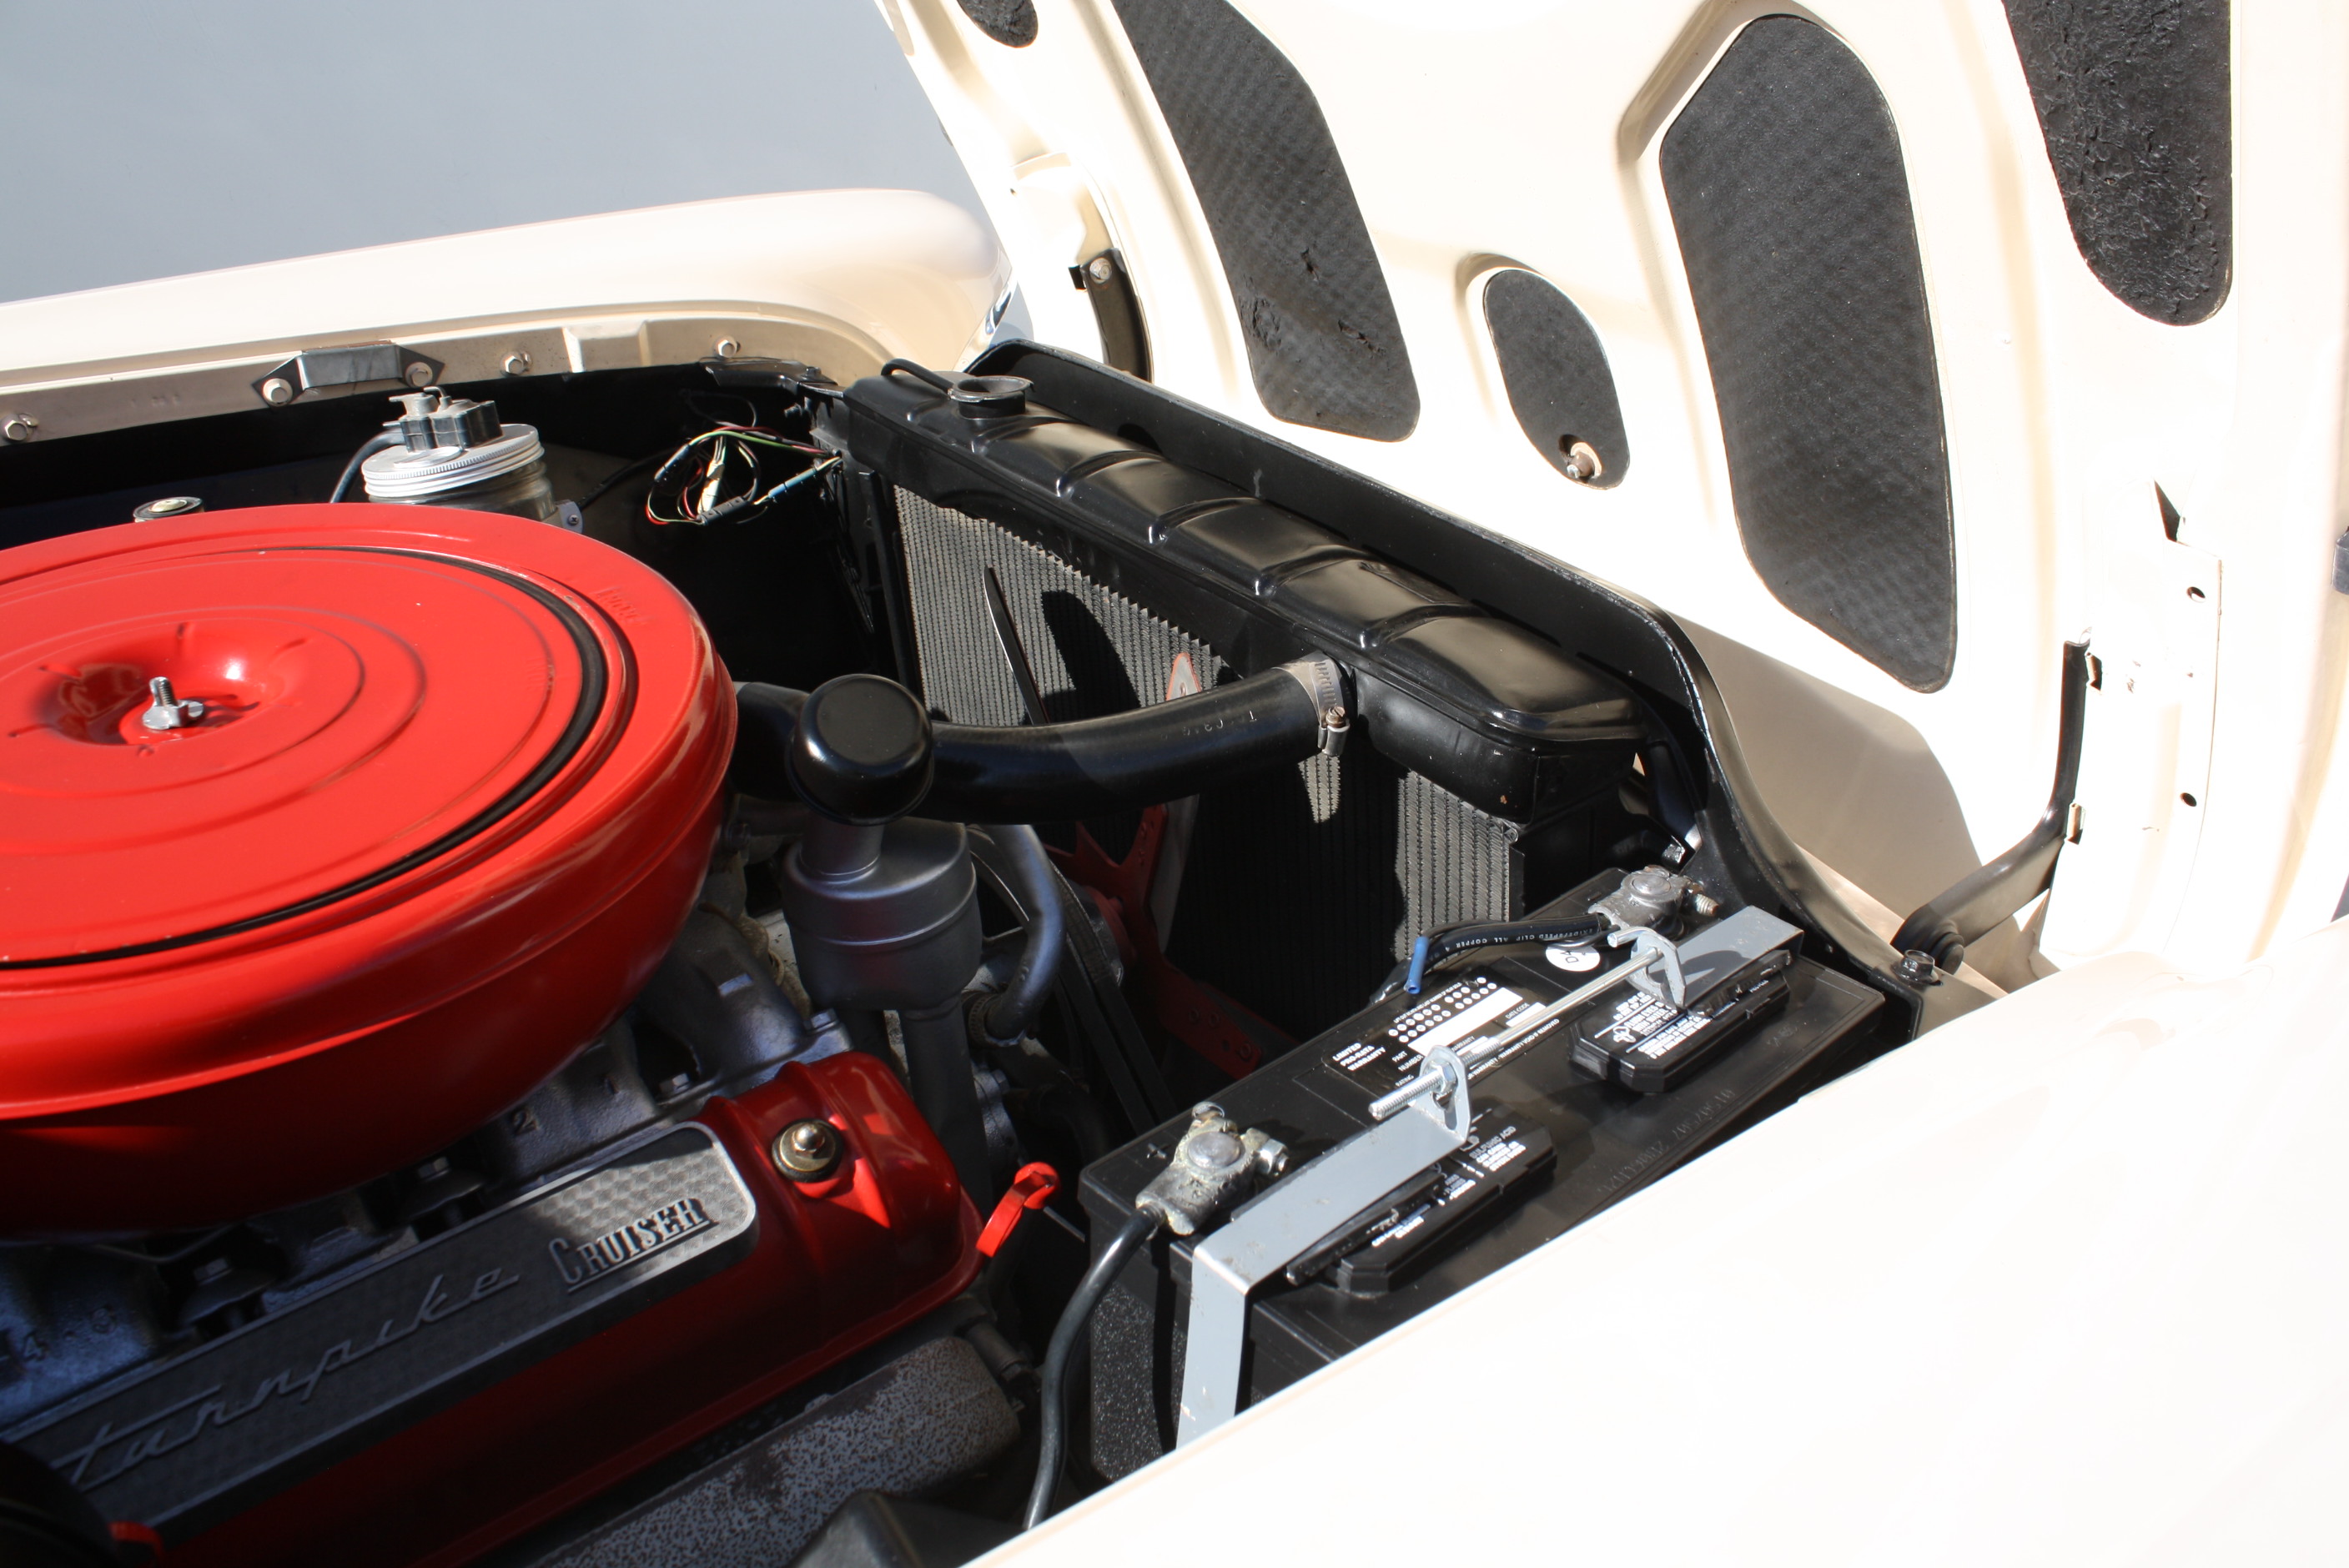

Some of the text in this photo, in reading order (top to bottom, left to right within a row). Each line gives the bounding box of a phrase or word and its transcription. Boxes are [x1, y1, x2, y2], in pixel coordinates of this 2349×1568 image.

[1456, 938, 1487, 948] COPPER
[1505, 1003, 1530, 1019] DATE CODE
[1332, 1043, 1361, 1062] LIMITED
[1340, 1045, 1375, 1067] PRO-RATA
[1347, 1047, 1386, 1071] WARRANTY
[1391, 1051, 1408, 1063] PART
[1398, 1054, 1424, 1072] NUMBER
[1395, 1074, 1415, 1087] RATING
[1500, 1126, 1517, 1139] ACID
